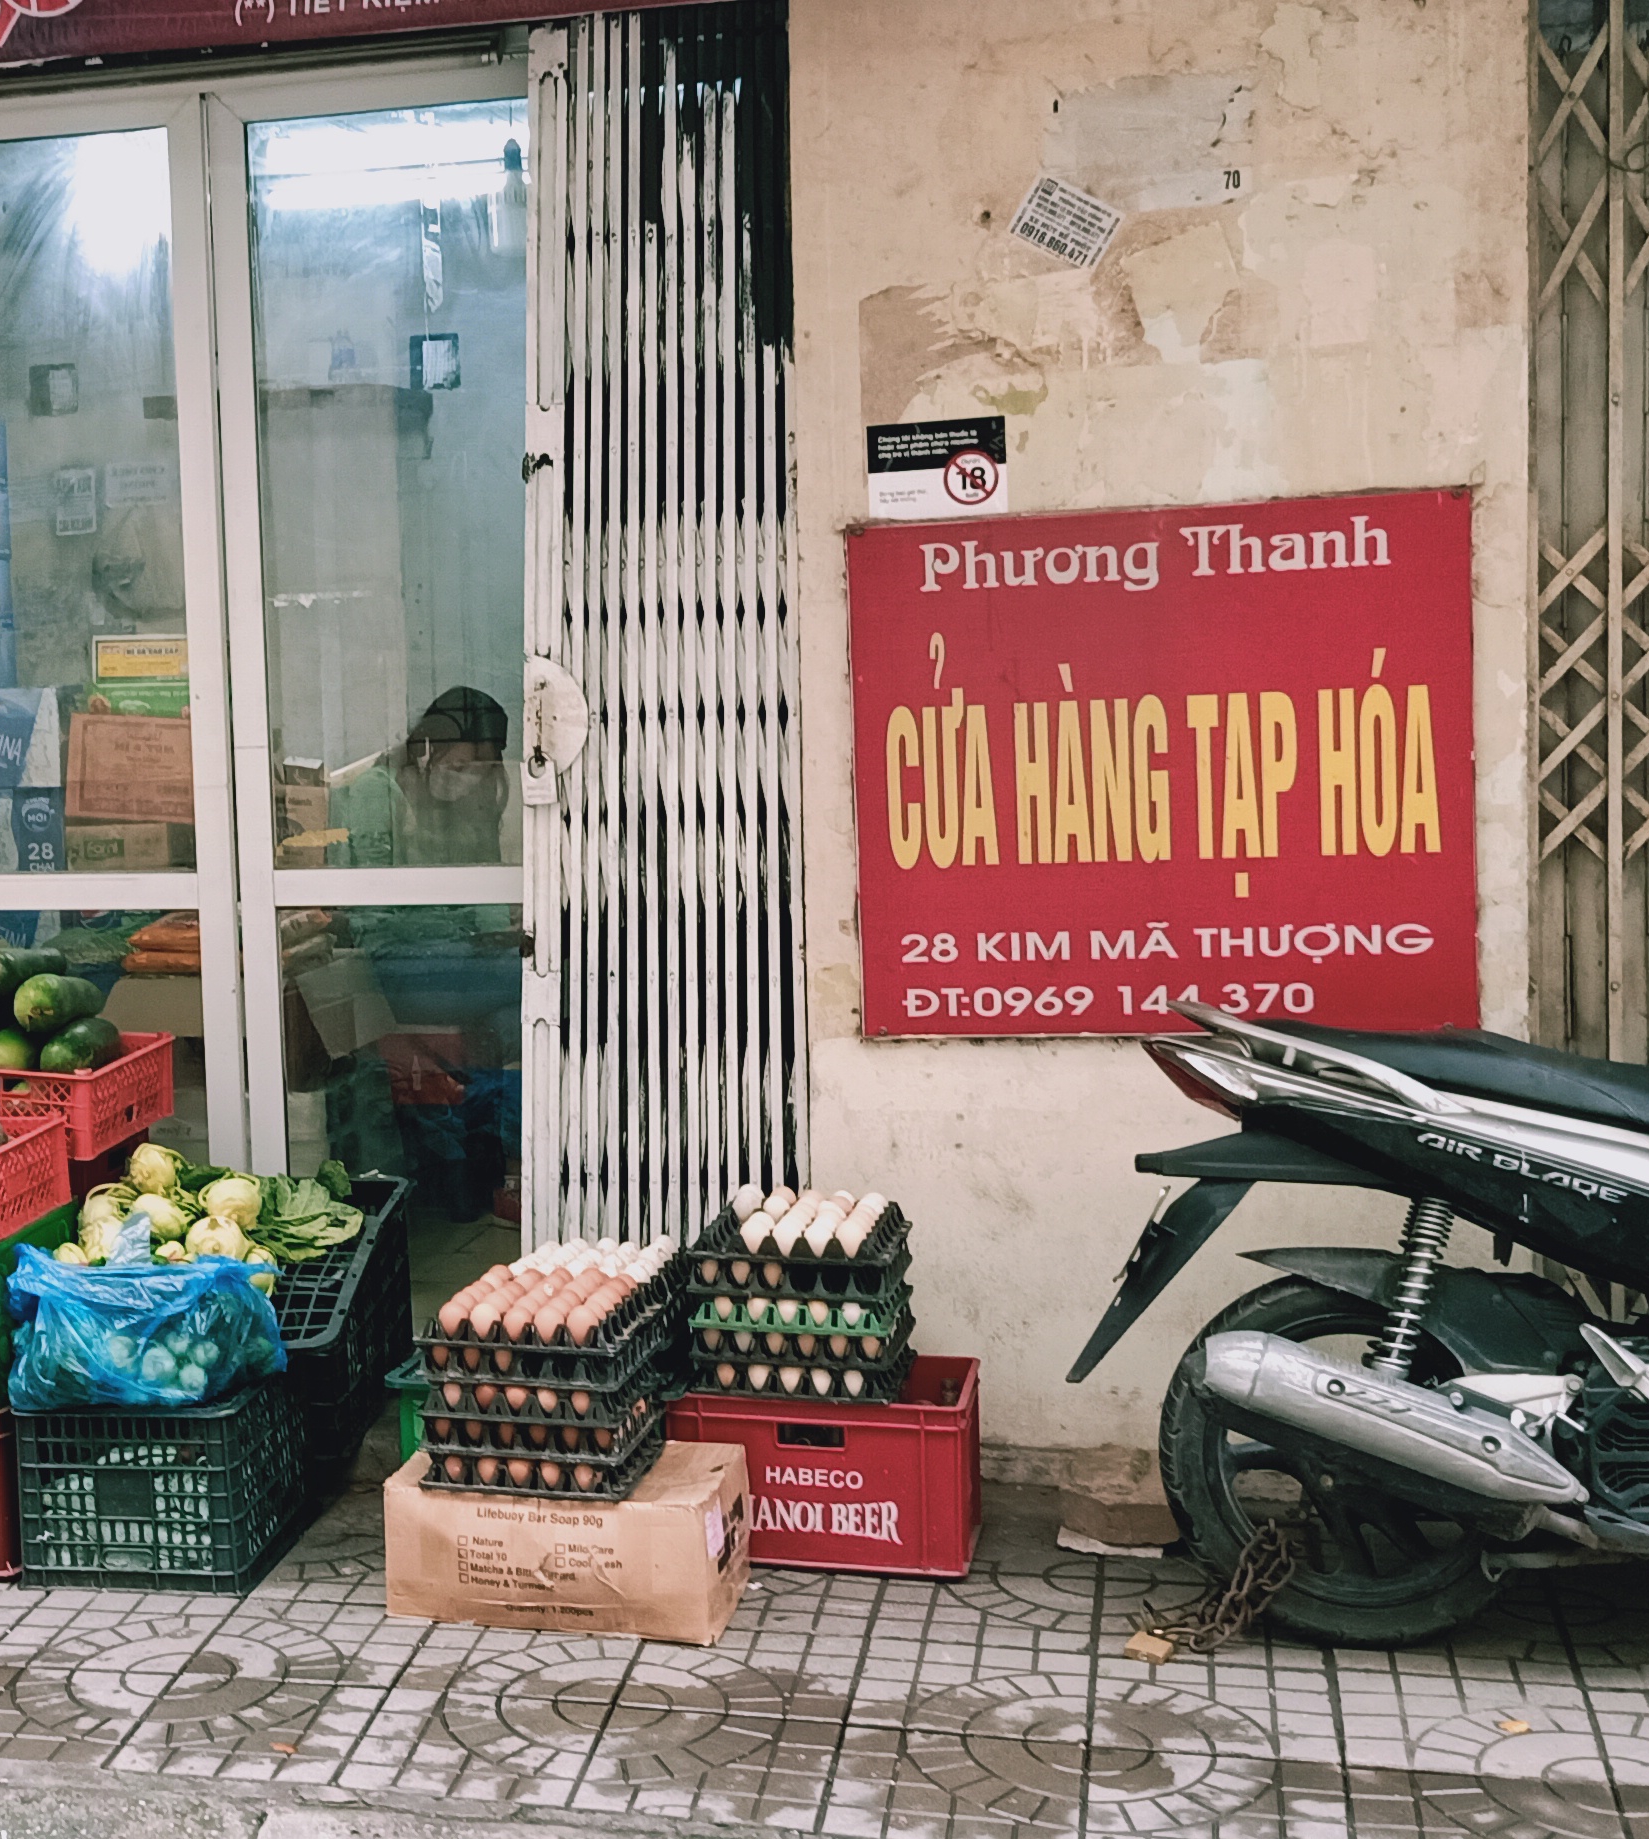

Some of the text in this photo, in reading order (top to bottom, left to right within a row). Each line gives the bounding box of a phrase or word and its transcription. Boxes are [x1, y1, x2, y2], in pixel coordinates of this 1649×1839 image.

[1223, 169, 1241, 190] 70
[956, 466, 987, 491] 18
[919, 515, 1392, 593] Phương Thanh
[885, 631, 1443, 899] CỬA HÀNG TẠP HÓA
[27, 842, 55, 861] 28
[901, 921, 1435, 965] 28 KIM MÃ THƯỢNG
[902, 982, 1315, 1018] ĐT:0969 144 370
[1417, 1132, 1630, 1204] AIR BLADE
[765, 1465, 864, 1490] HABECO
[477, 1507, 604, 1529] Lifebuoy Bar Soap 90g
[830, 1500, 904, 1546] BEER
[472, 1536, 504, 1547] Nature
[469, 1549, 494, 1561] Total
[470, 1563, 504, 1575] Matcha
